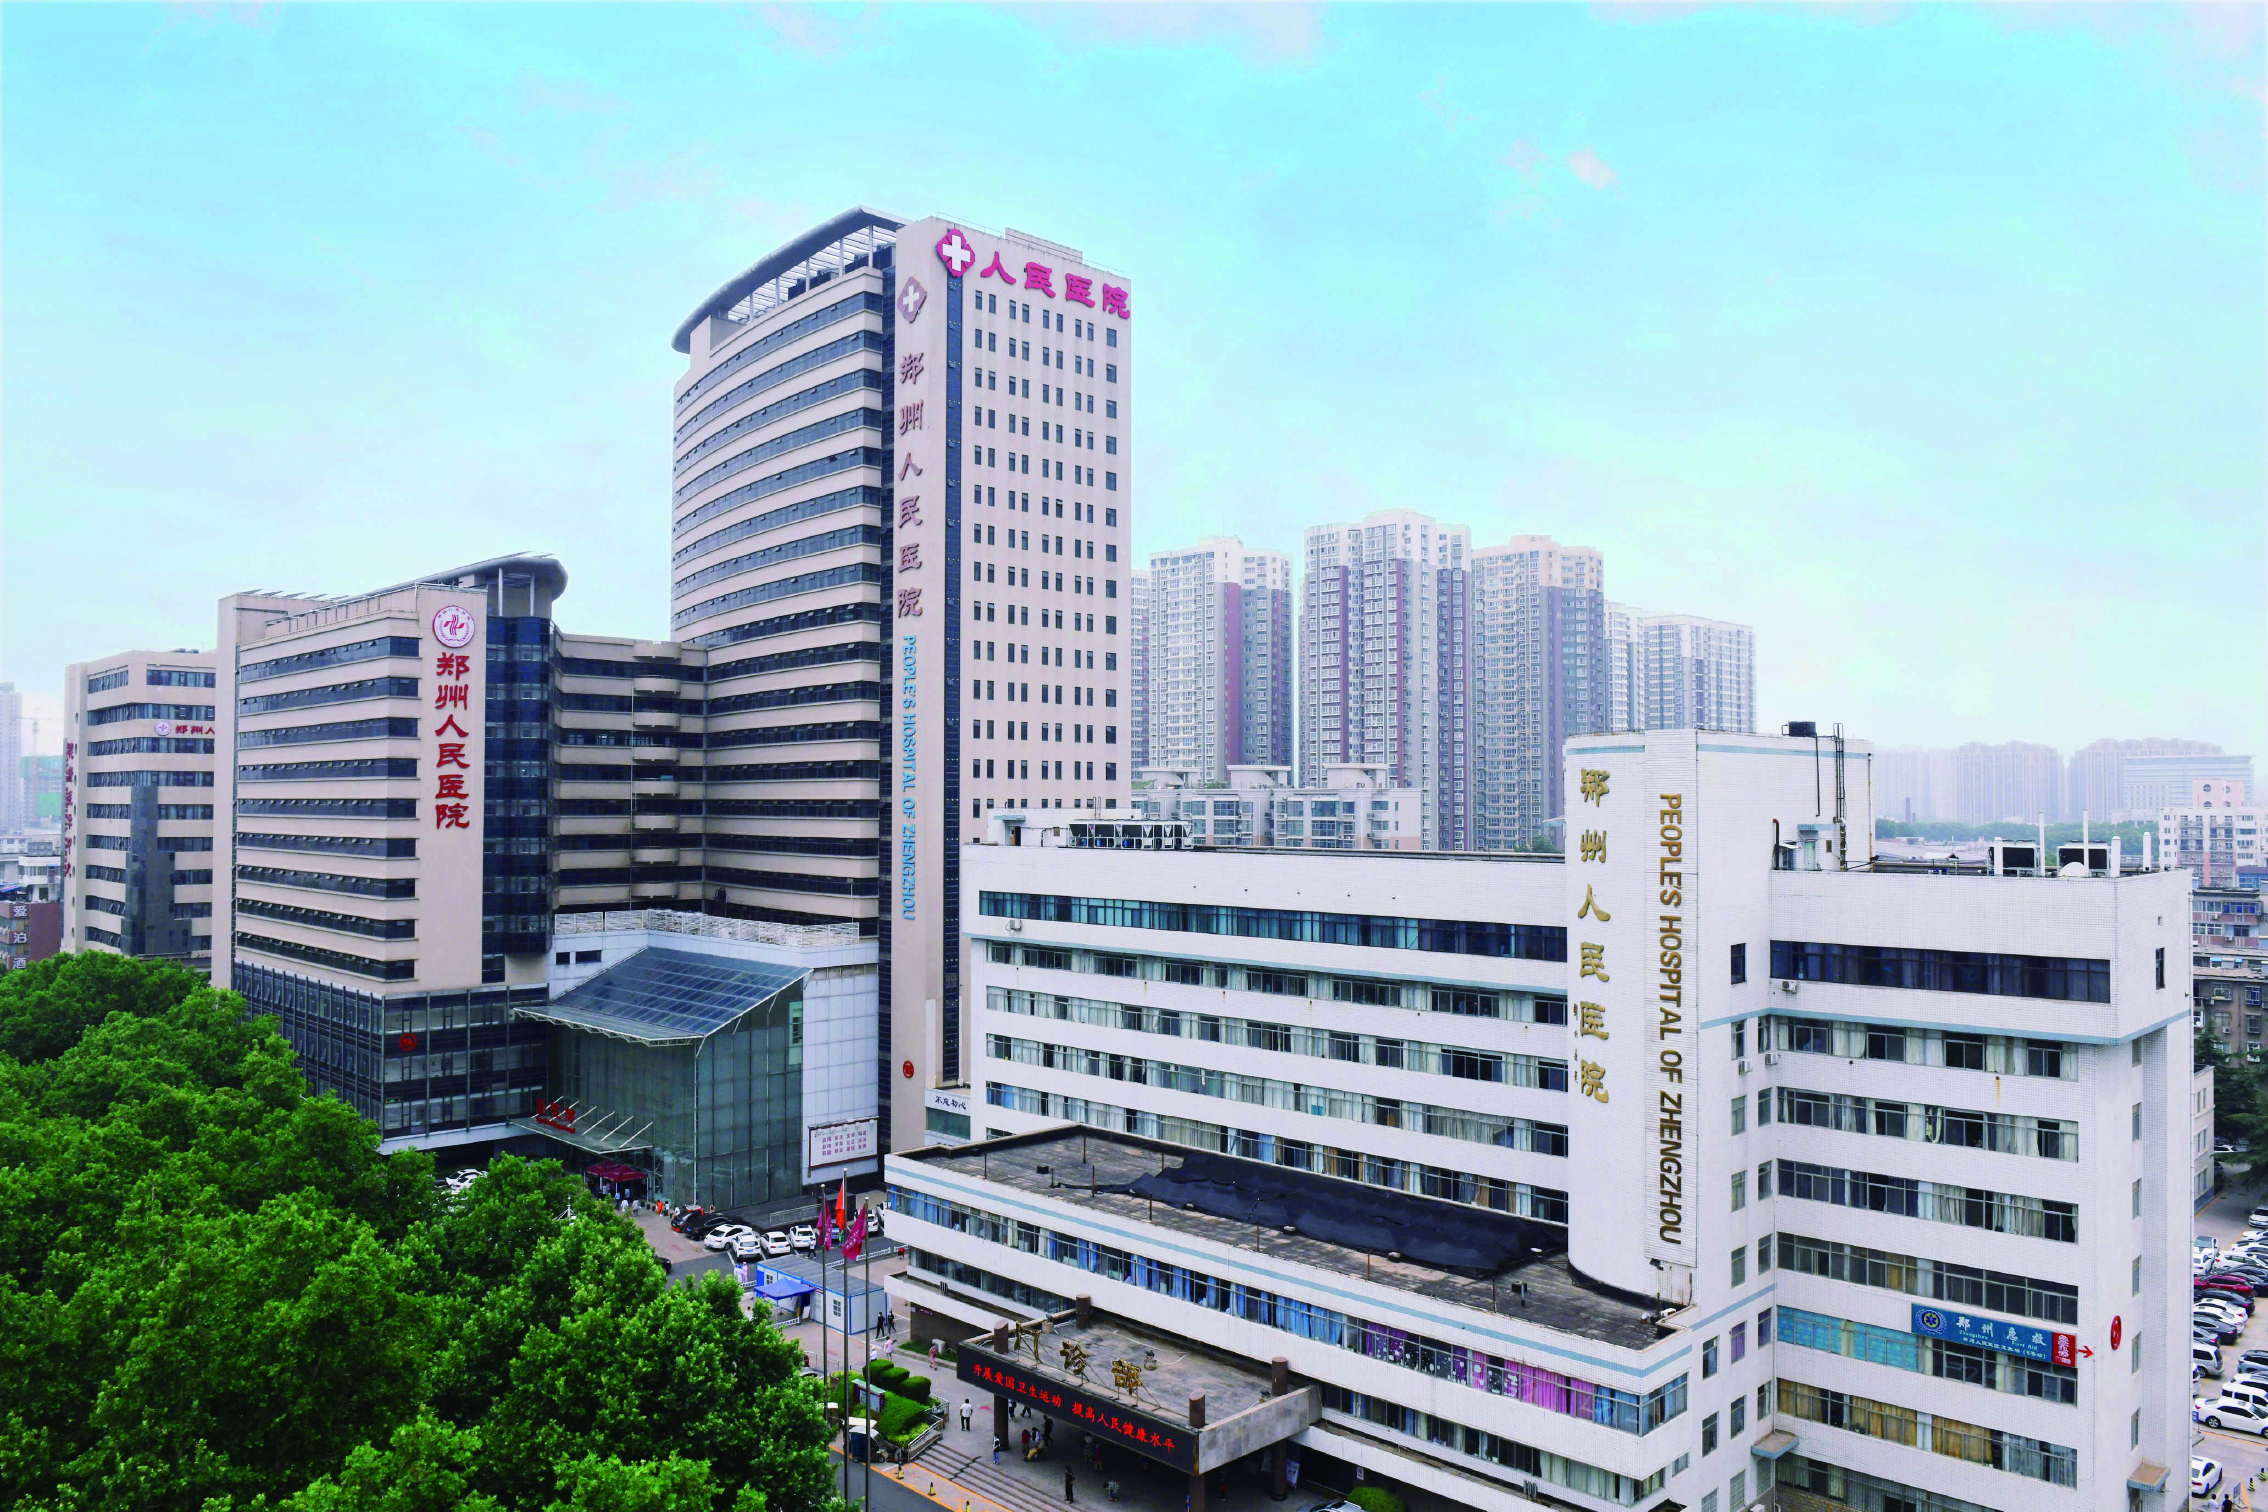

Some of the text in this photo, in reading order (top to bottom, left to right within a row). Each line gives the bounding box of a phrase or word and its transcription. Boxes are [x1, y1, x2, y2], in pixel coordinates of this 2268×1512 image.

[980, 251, 1131, 319] 人民医院
[897, 351, 925, 618] 郑州人民医院
[435, 651, 471, 830] 郑州人民医院
[901, 635, 916, 920] PEOPLE'S HOSPITAL OF ZHENGZHOU
[1577, 768, 1611, 1104] 郑州人民医院
[1660, 793, 1683, 1245] PEOPLE'S HOSPITAL OF ZHENGZHOU
[934, 1095, 967, 1110] 不忘初心
[1013, 1320, 1143, 1396] 门诊部
[1956, 1316, 2046, 1346] 郑州急救
[973, 1363, 1176, 1453] 开展爱国卫生运动 提高人民健康水平
